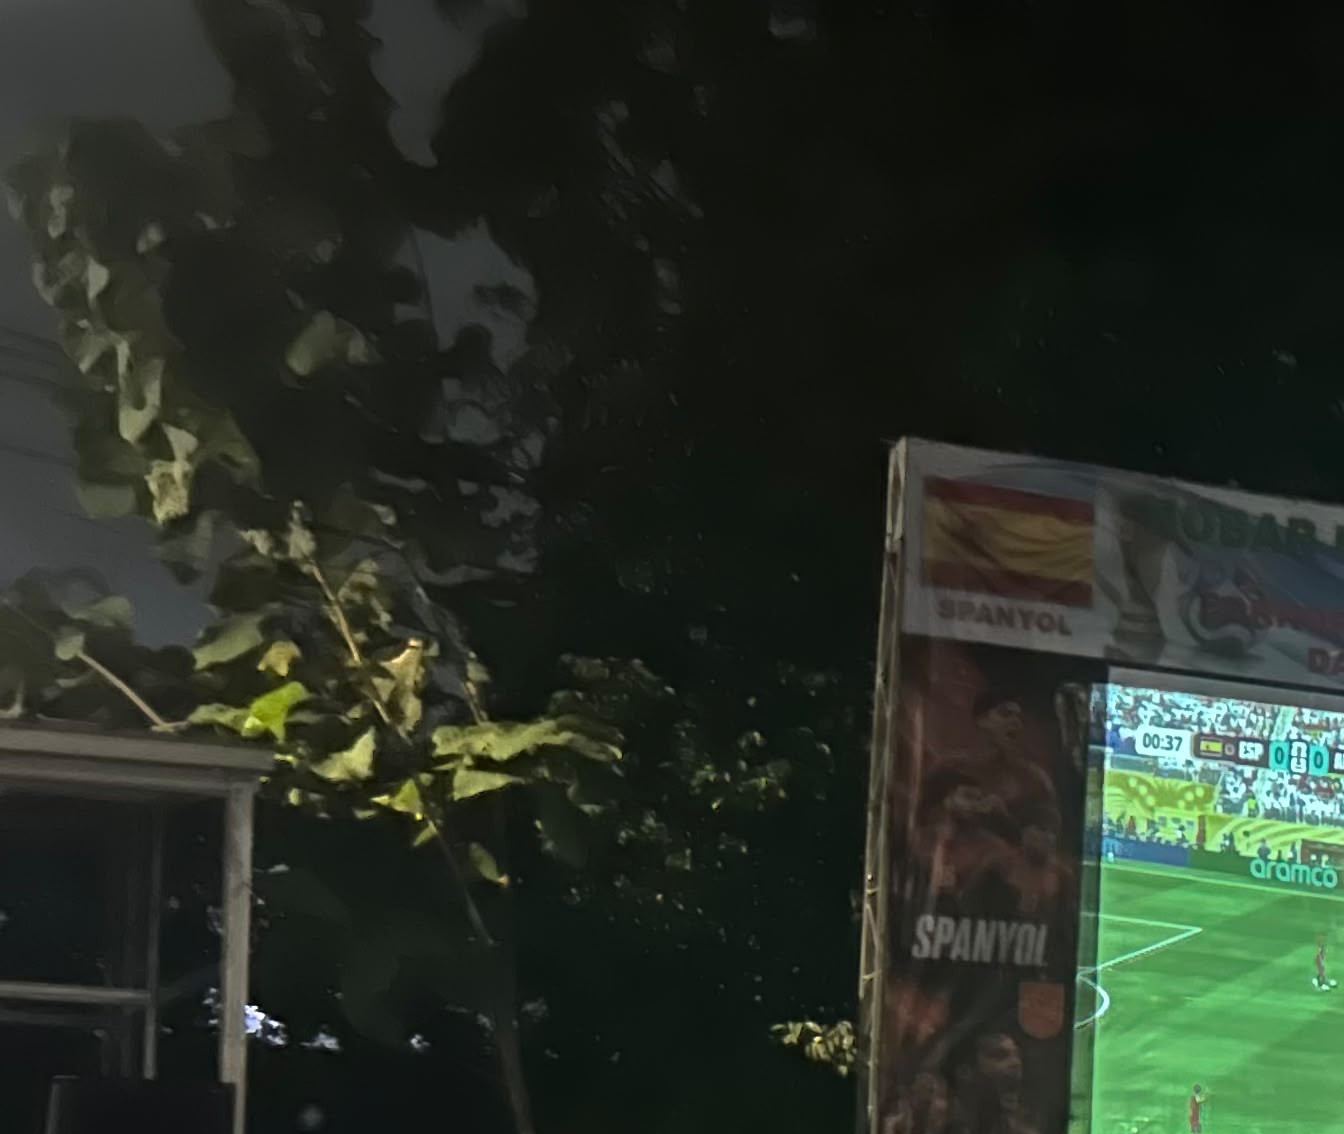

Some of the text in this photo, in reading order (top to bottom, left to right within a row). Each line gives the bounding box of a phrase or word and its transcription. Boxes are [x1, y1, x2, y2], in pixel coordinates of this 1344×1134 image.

[1152, 498, 1317, 557] OBAR
[937, 597, 1072, 637] SPANYOL
[1142, 732, 1183, 752] 00:37
[1238, 740, 1264, 761] ESP
[1250, 857, 1339, 889] aramco
[911, 914, 1048, 966] SPANYOL
